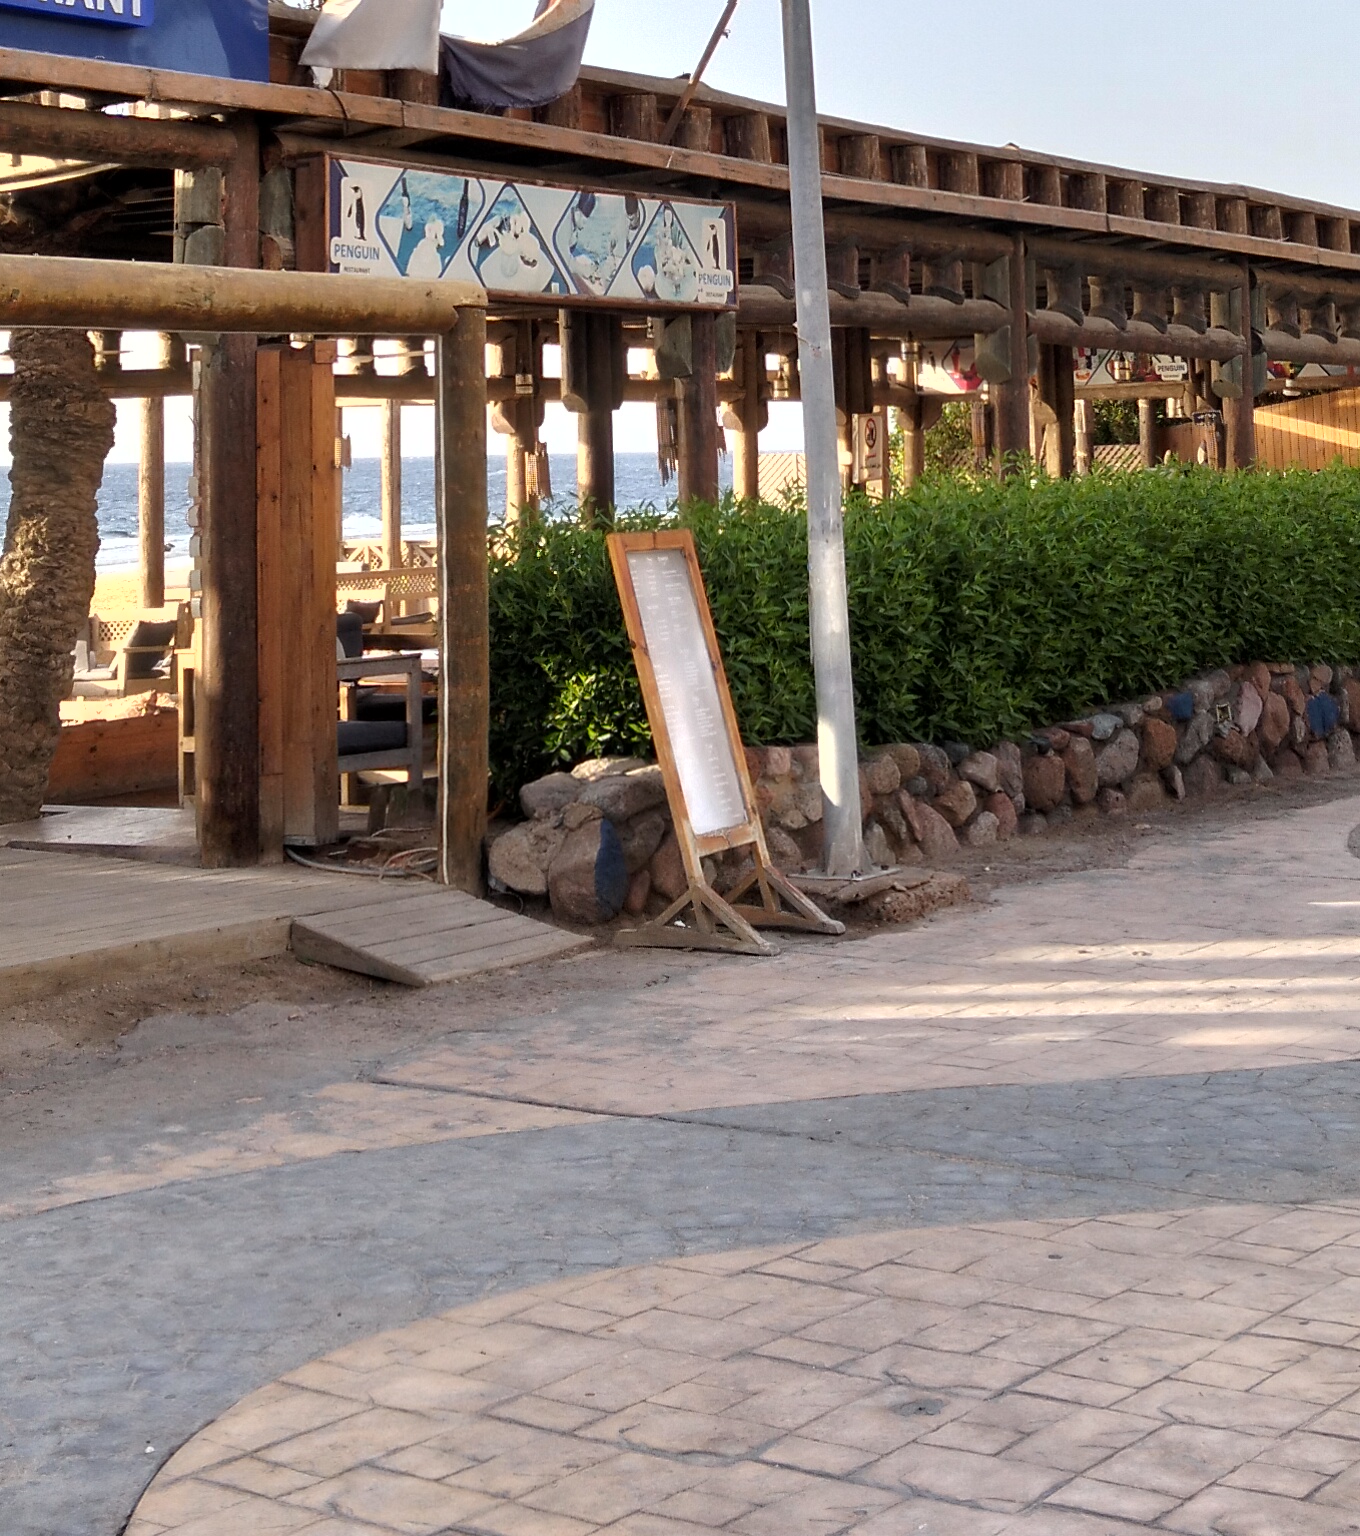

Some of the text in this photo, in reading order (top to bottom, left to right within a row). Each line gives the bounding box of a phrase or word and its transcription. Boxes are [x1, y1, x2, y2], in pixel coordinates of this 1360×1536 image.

[334, 243, 380, 260] PENGUIN
[698, 273, 731, 287] PENGUIN
[1157, 365, 1186, 373] PENGUIN
